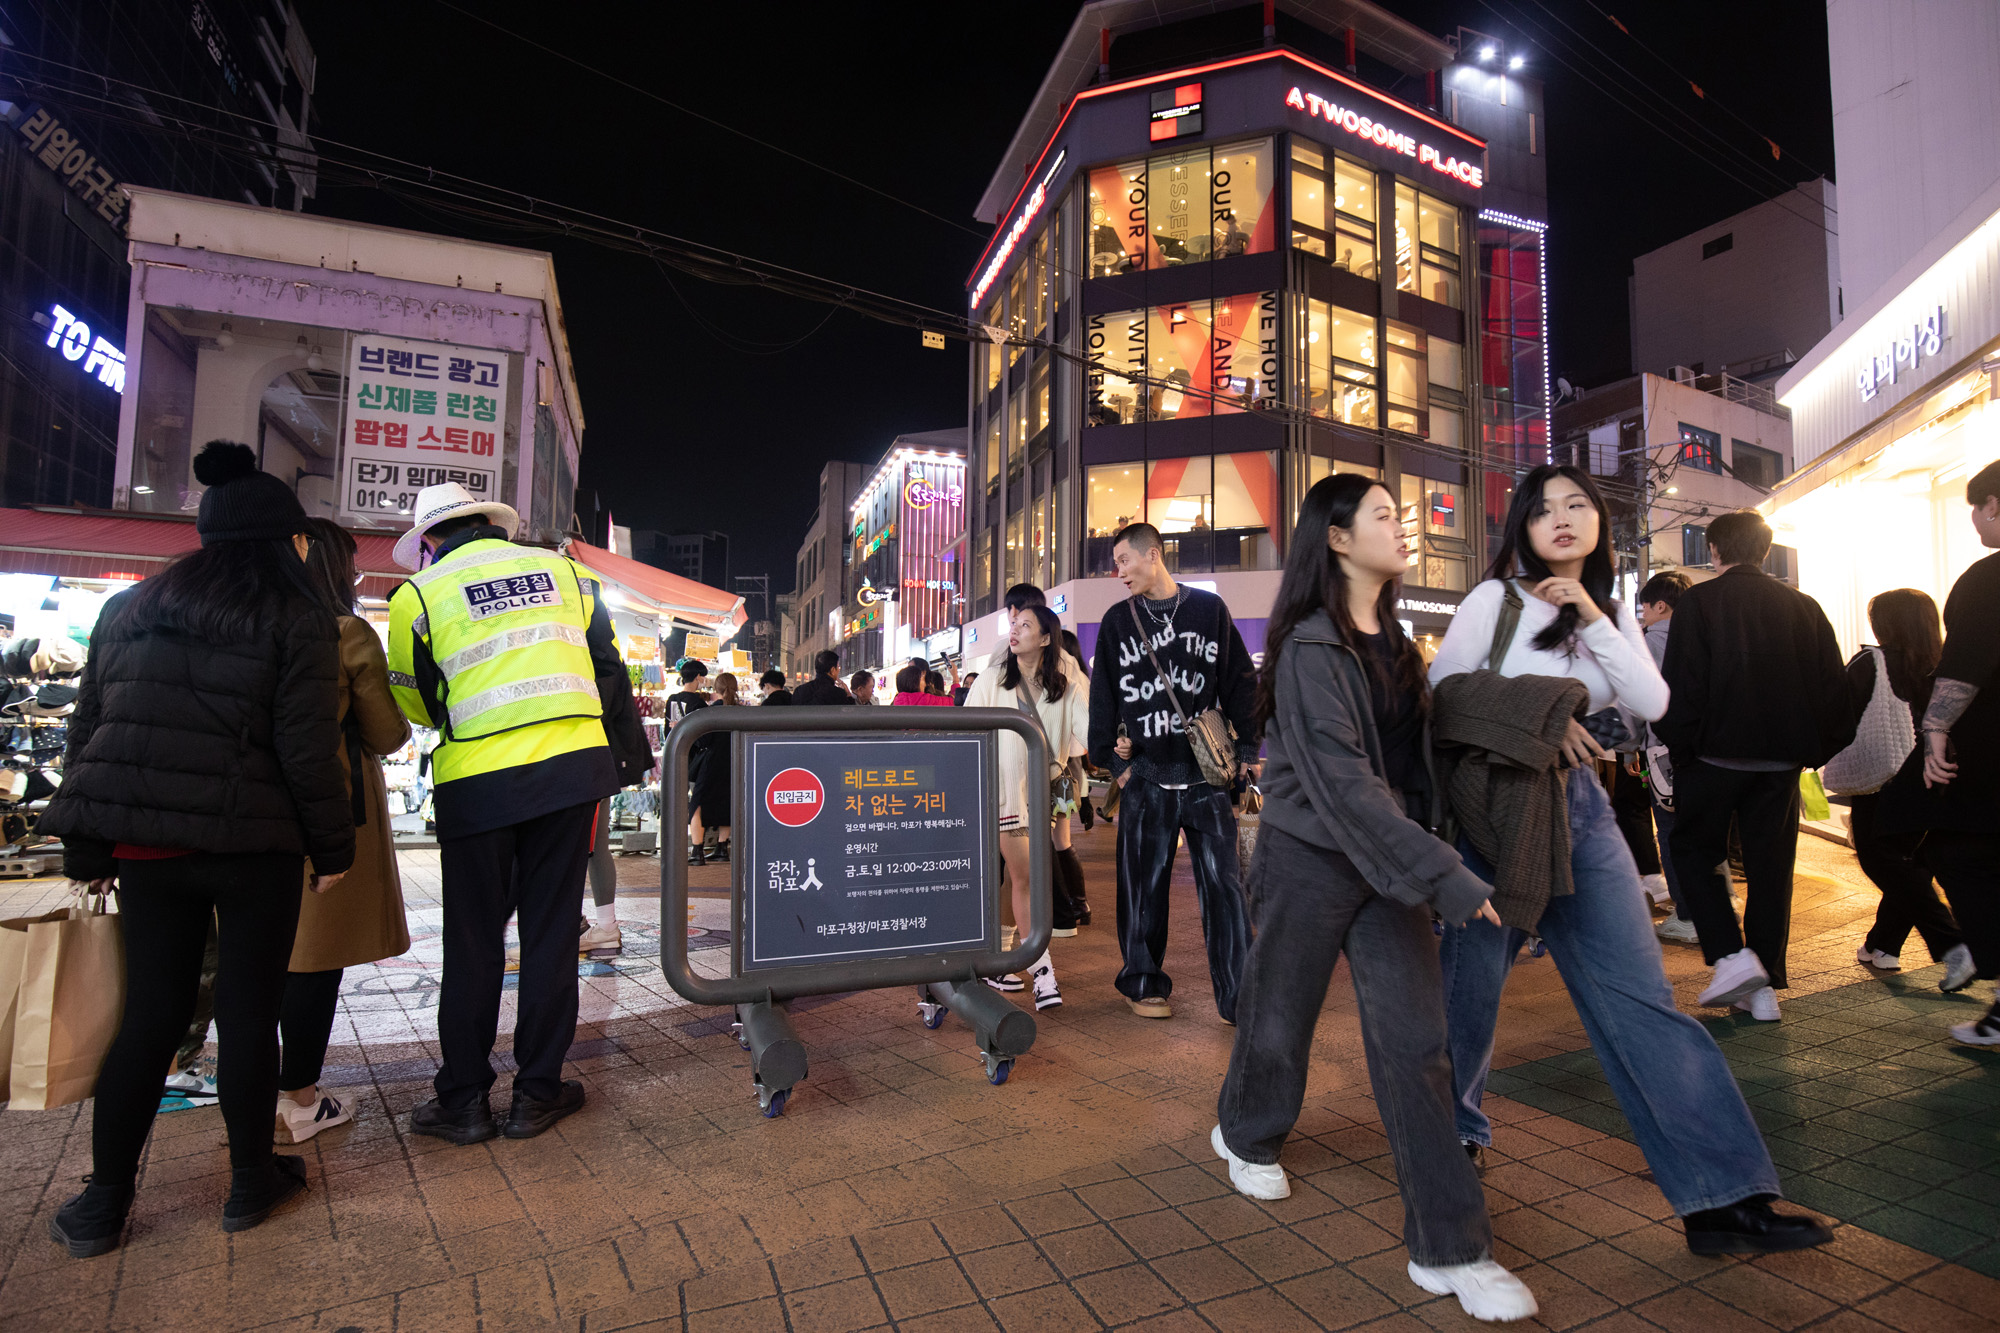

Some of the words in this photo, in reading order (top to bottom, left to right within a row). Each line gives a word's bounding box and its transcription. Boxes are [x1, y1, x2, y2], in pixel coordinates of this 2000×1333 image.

[1286, 86, 1305, 111] A
[1305, 92, 1416, 158] TWOSOME
[1419, 143, 1483, 188] PLACE
[1128, 172, 1146, 239] YOUR
[1213, 170, 1231, 223] OUR
[1261, 291, 1276, 330] WE
[46, 304, 91, 361] TO
[358, 346, 440, 380] 브랜드
[448, 356, 499, 388] 광고
[1214, 337, 1232, 391] AND
[357, 383, 438, 416] 신제품
[446, 392, 497, 423] 런칭
[354, 419, 409, 449] 팝업
[416, 425, 495, 457] 스토어
[357, 462, 400, 486] 단기
[406, 467, 488, 493] 임대문의
[470, 574, 550, 602] 교통경찰
[480, 593, 552, 615] POLICE
[1397, 598, 1406, 610] A
[1405, 599, 1456, 616] TWOSOME
[844, 768, 919, 790] 레드로드
[776, 791, 815, 804] 진입금지
[844, 795, 864, 816] 차
[870, 794, 907, 816] 없는
[913, 791, 946, 814] 거리
[845, 822, 867, 833] 걸으면
[900, 820, 923, 830] 마포가
[924, 818, 967, 830] 행복해집니다.
[844, 842, 879, 854] 운영시간
[767, 859, 800, 878] 걷자,
[845, 863, 883, 878] 금.토.일
[886, 857, 971, 875] 12:00~23:00까지
[769, 877, 800, 894] 마포
[816, 915, 927, 937] 마포구청장/마포경찰서장
